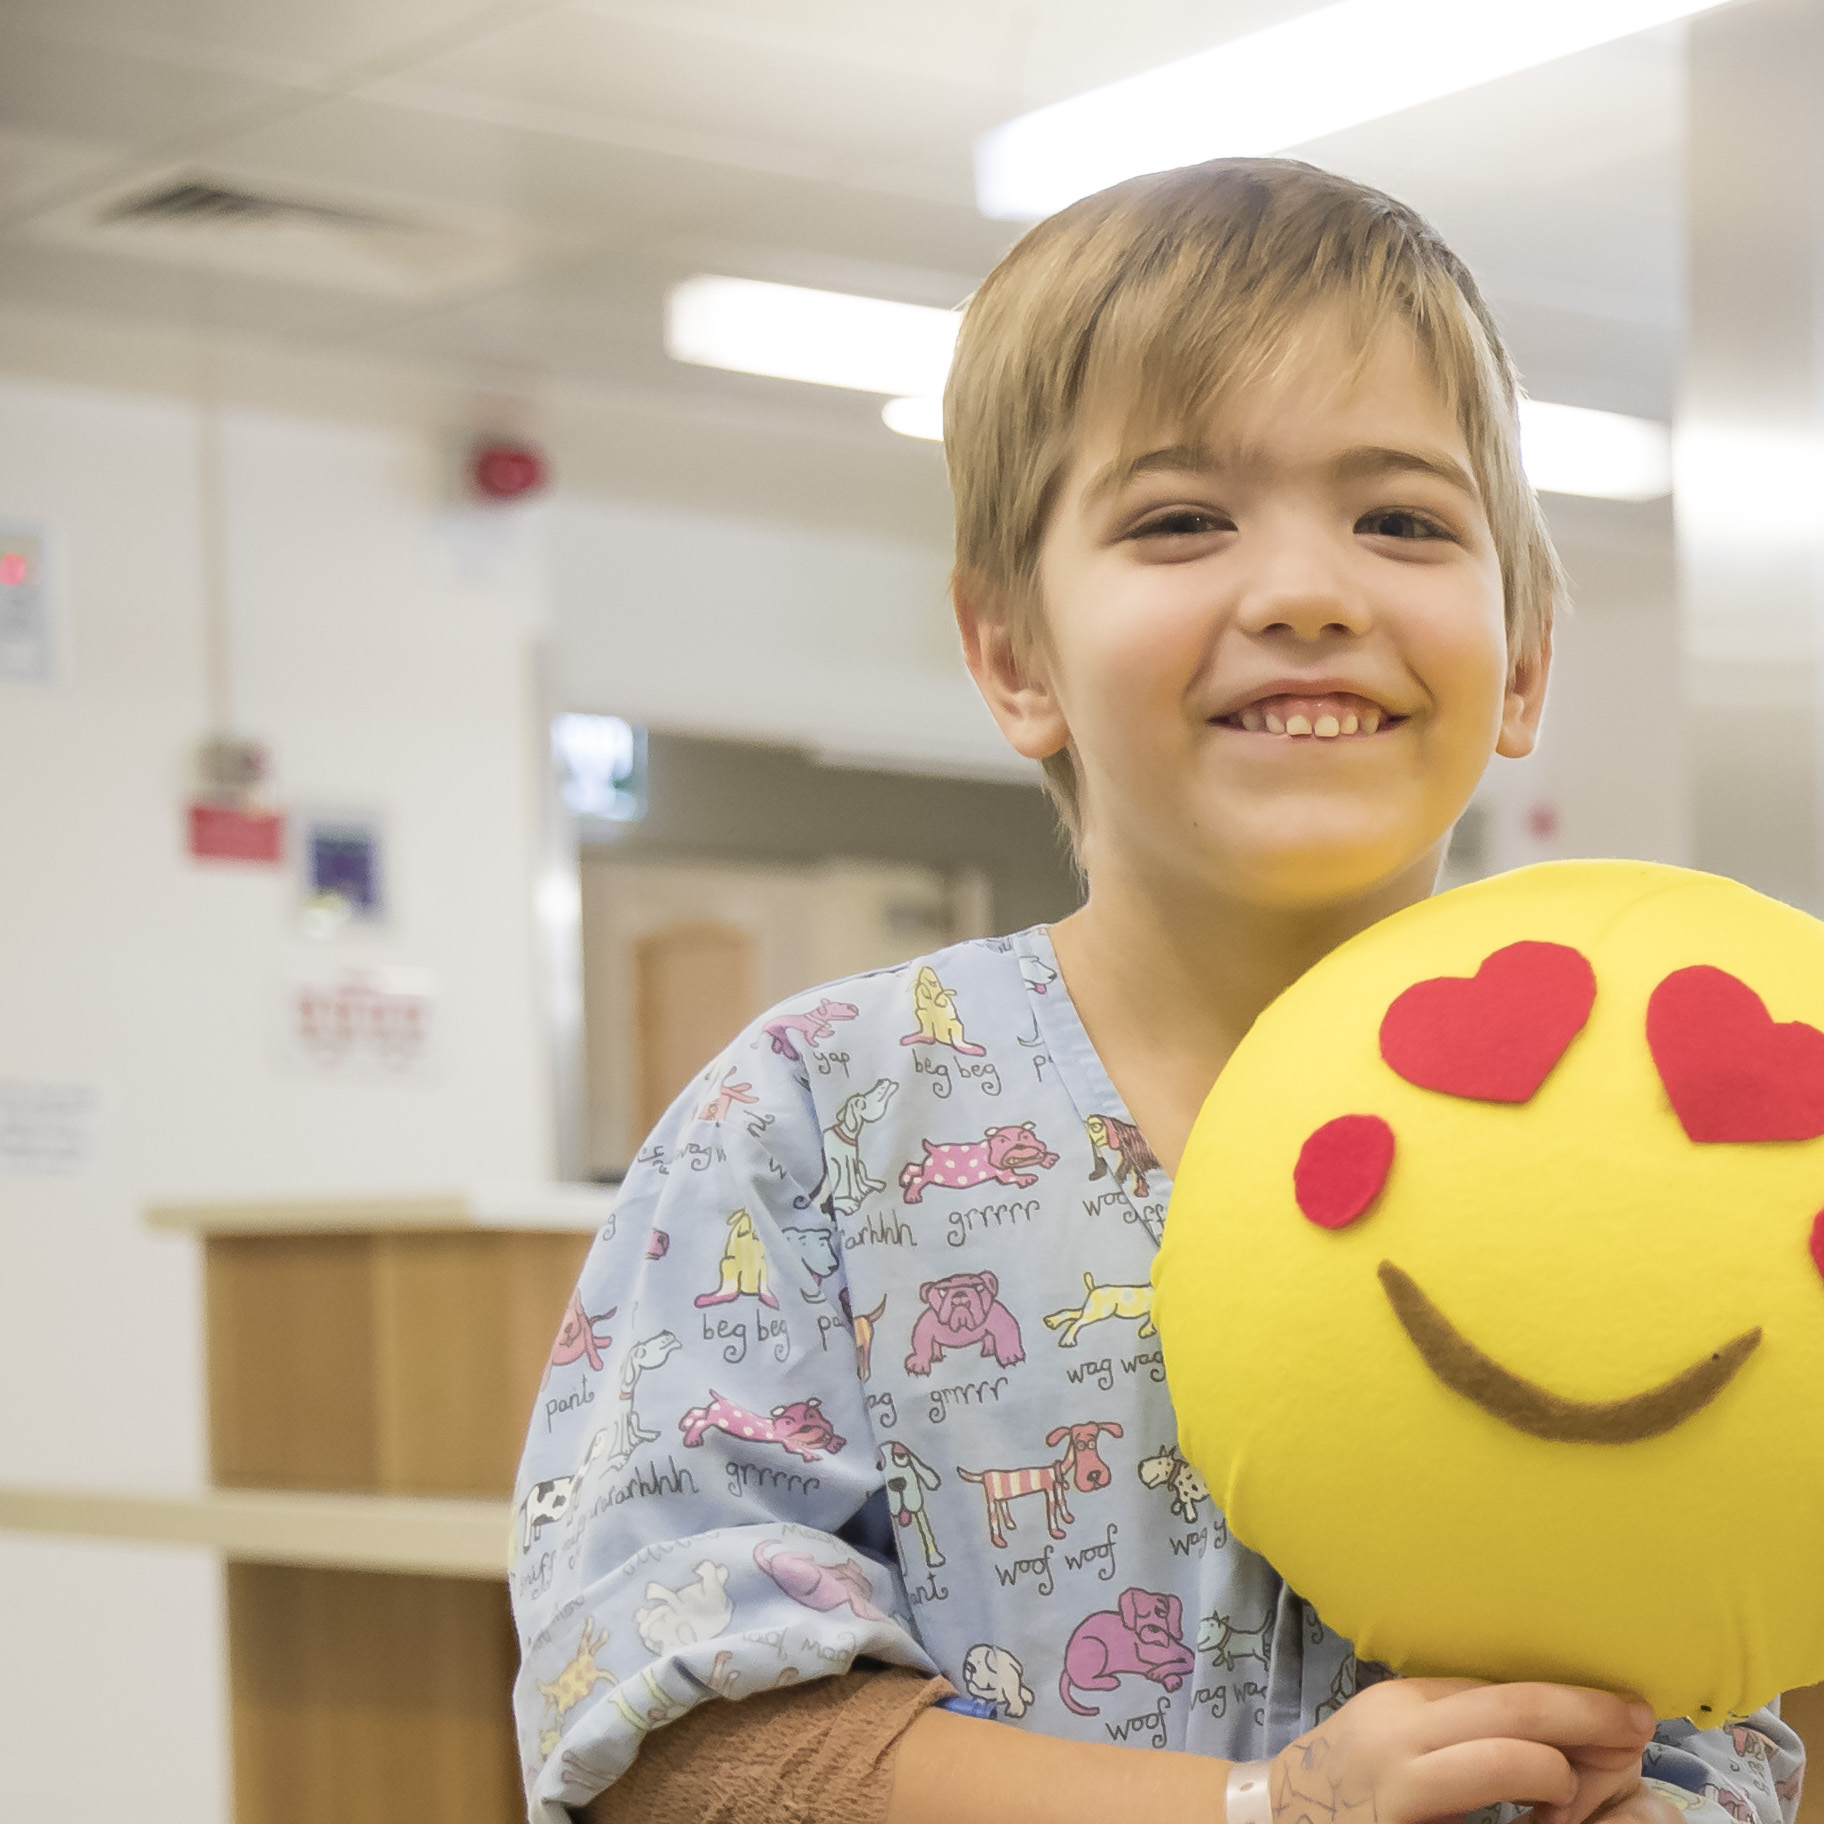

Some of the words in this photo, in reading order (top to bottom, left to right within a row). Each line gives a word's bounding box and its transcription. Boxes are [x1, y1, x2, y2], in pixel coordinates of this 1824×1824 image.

[813, 1051, 850, 1077] yap
[912, 1048, 951, 1099] beg
[954, 1055, 1001, 1096] beg
[703, 1313, 747, 1363] beg
[757, 1309, 790, 1362] beg
[1067, 1358, 1113, 1390] wag
[546, 1375, 595, 1433] pant
[995, 1545, 1055, 1595] woof
[1065, 1523, 1118, 1580] woof
[1105, 1696, 1171, 1749] woof
